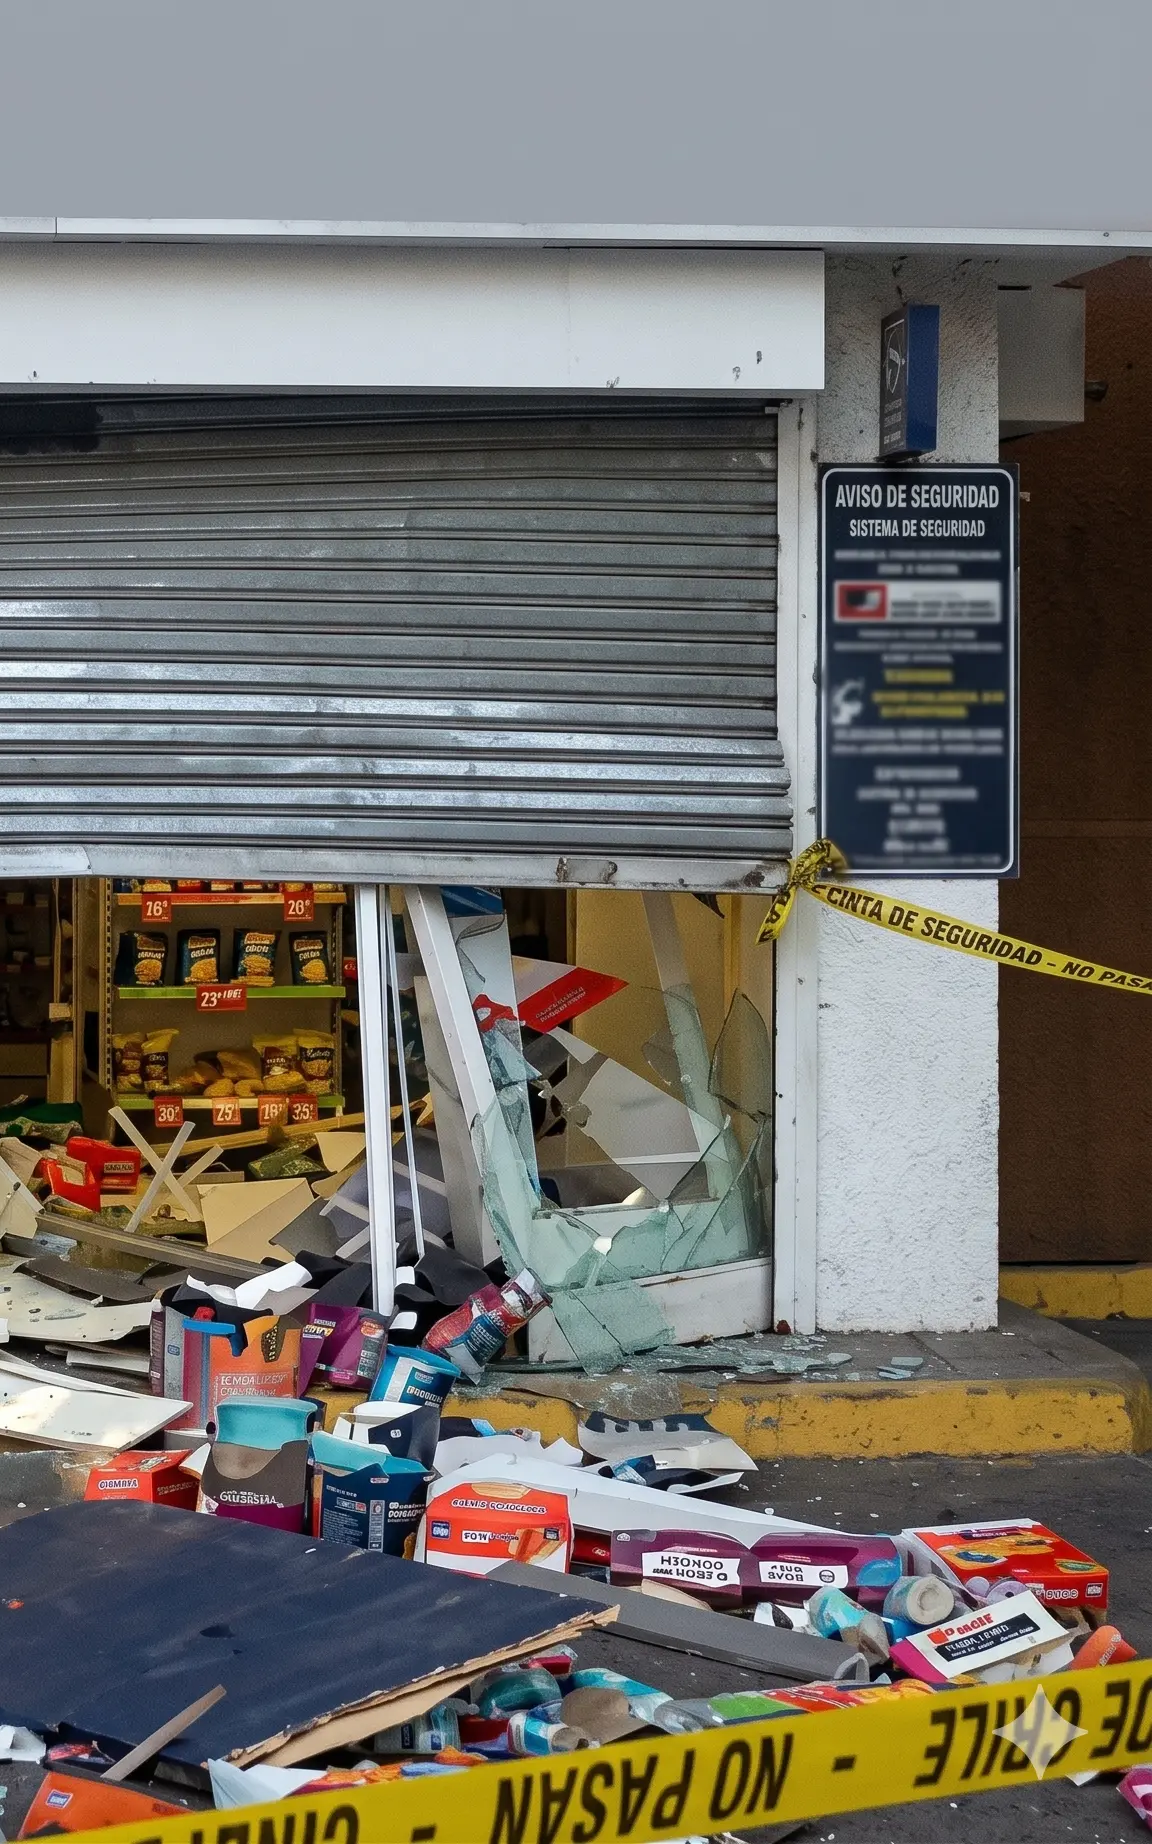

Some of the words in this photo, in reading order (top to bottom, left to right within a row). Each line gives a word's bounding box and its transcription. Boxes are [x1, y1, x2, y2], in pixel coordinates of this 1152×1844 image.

[835, 484, 882, 508] AVISO
[887, 485, 907, 508] DE
[911, 485, 999, 508] SEGURIDAD
[849, 519, 899, 537] SISTEMA
[902, 520, 917, 537] DE
[920, 520, 986, 537] SEGURIDAD
[826, 886, 883, 921] CINTA
[887, 906, 919, 932] DE
[920, 916, 1042, 966] SEGURIDAD
[1061, 961, 1095, 978] NO
[486, 1748, 697, 1844] PASAN
[709, 1732, 795, 1823] NO
